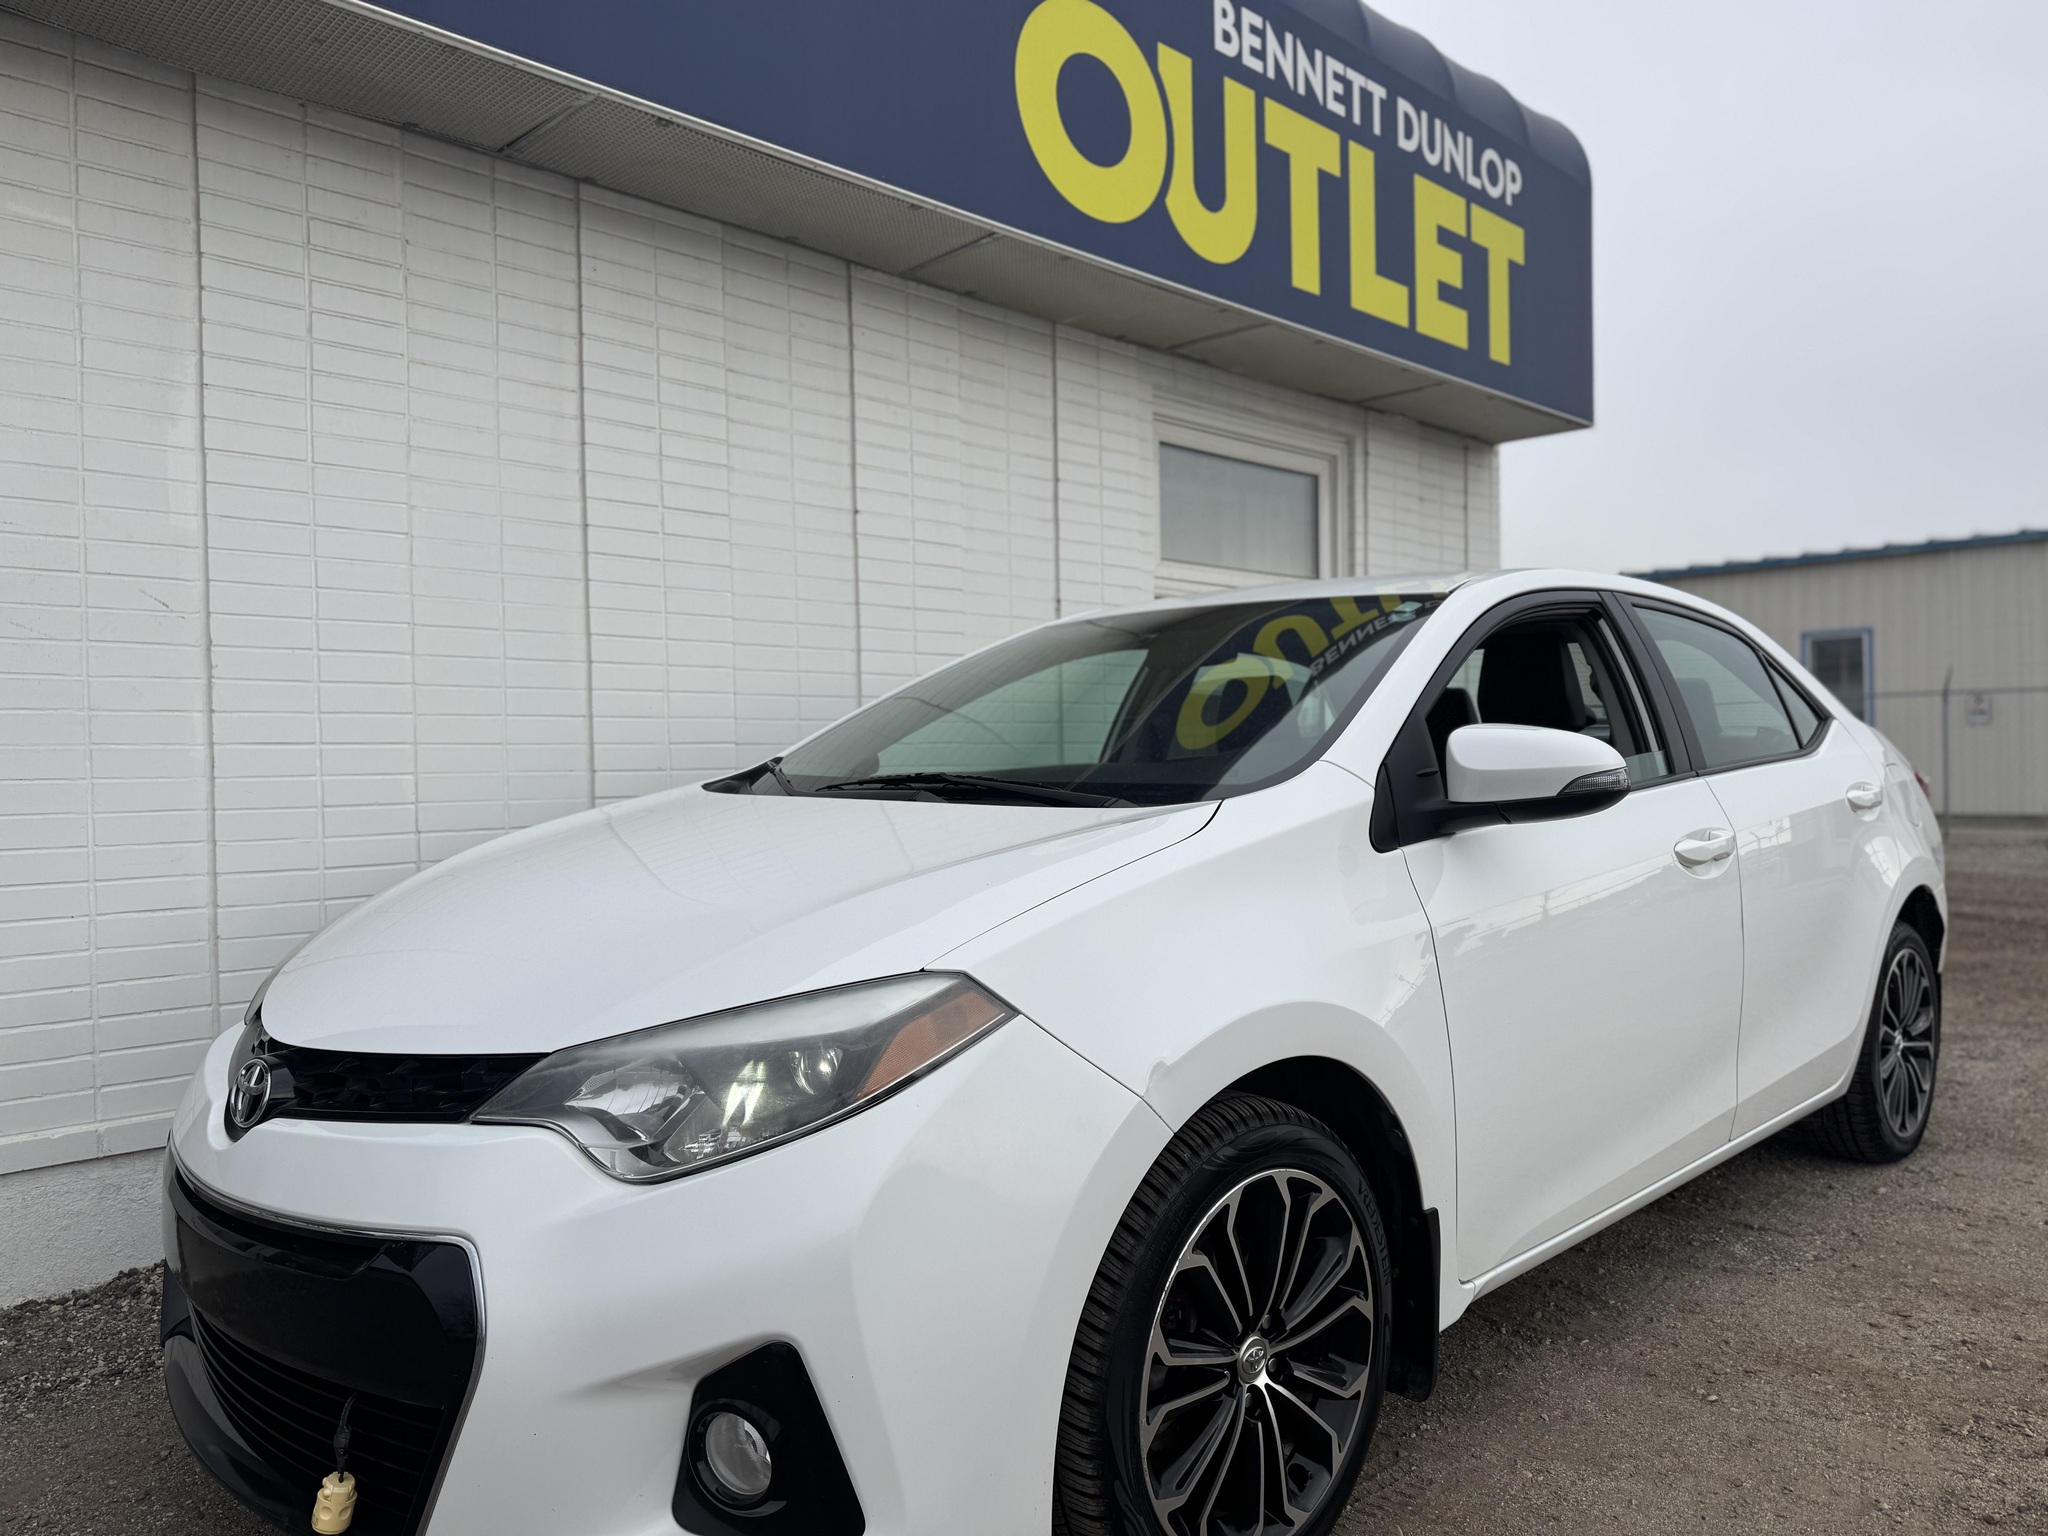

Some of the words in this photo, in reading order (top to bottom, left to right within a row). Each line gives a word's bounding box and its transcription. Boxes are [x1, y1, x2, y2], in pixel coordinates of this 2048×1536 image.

[1015, 0, 1525, 366] OUTLET
[1213, 0, 1387, 136] BENNETT
[1397, 96, 1523, 206] DUNLOP
[1357, 1177, 1393, 1287] VREDESTEIN
